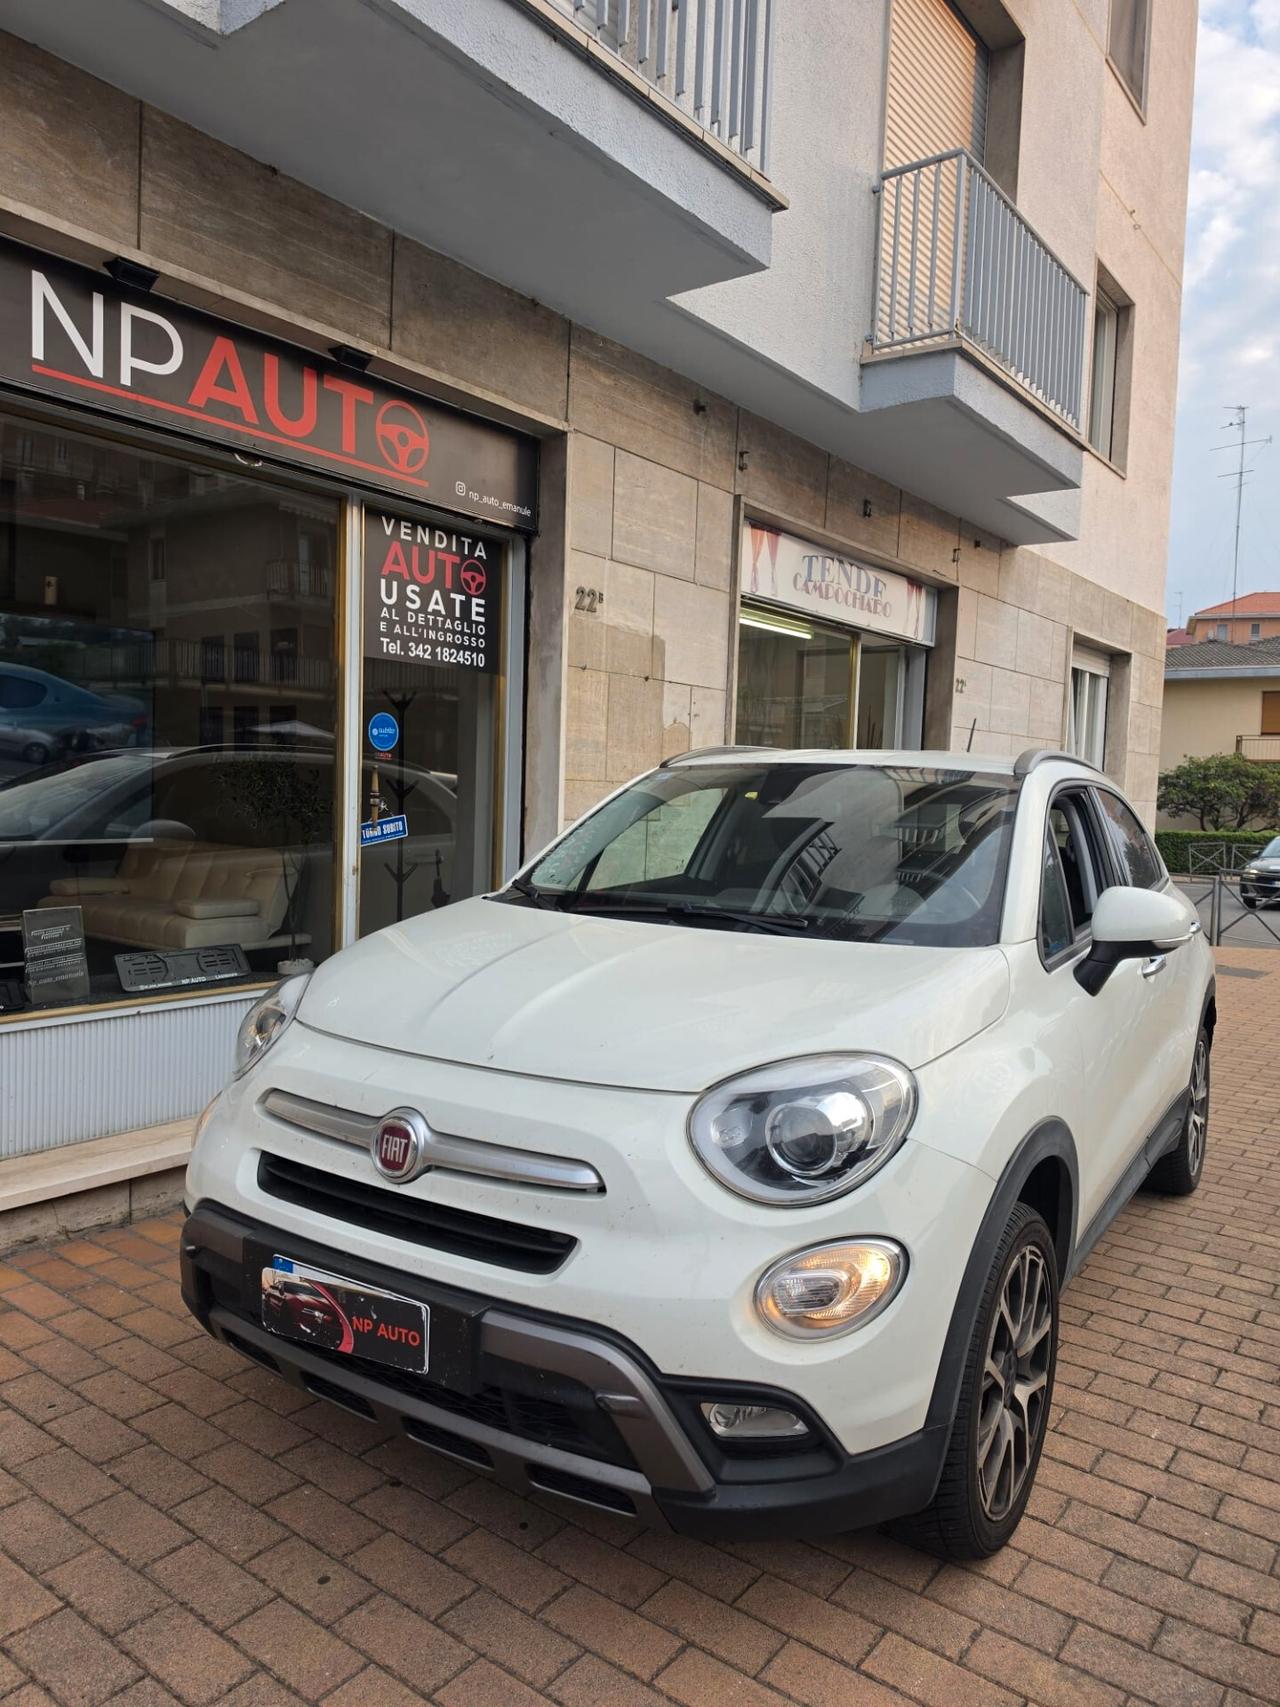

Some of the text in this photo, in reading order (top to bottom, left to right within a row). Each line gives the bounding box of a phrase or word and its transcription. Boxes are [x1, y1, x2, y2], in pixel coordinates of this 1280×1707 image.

[381, 516, 487, 560] VENDITA
[380, 540, 487, 596] AUTO
[380, 578, 486, 622] USATE
[380, 607, 486, 635] AL DETTAGLIO
[380, 622, 486, 648] E ALL'INGROSSO
[380, 637, 486, 668] Tel. 342 1824510
[382, 1134, 408, 1163] FIAT
[352, 1316, 420, 1347] NP AUTO
